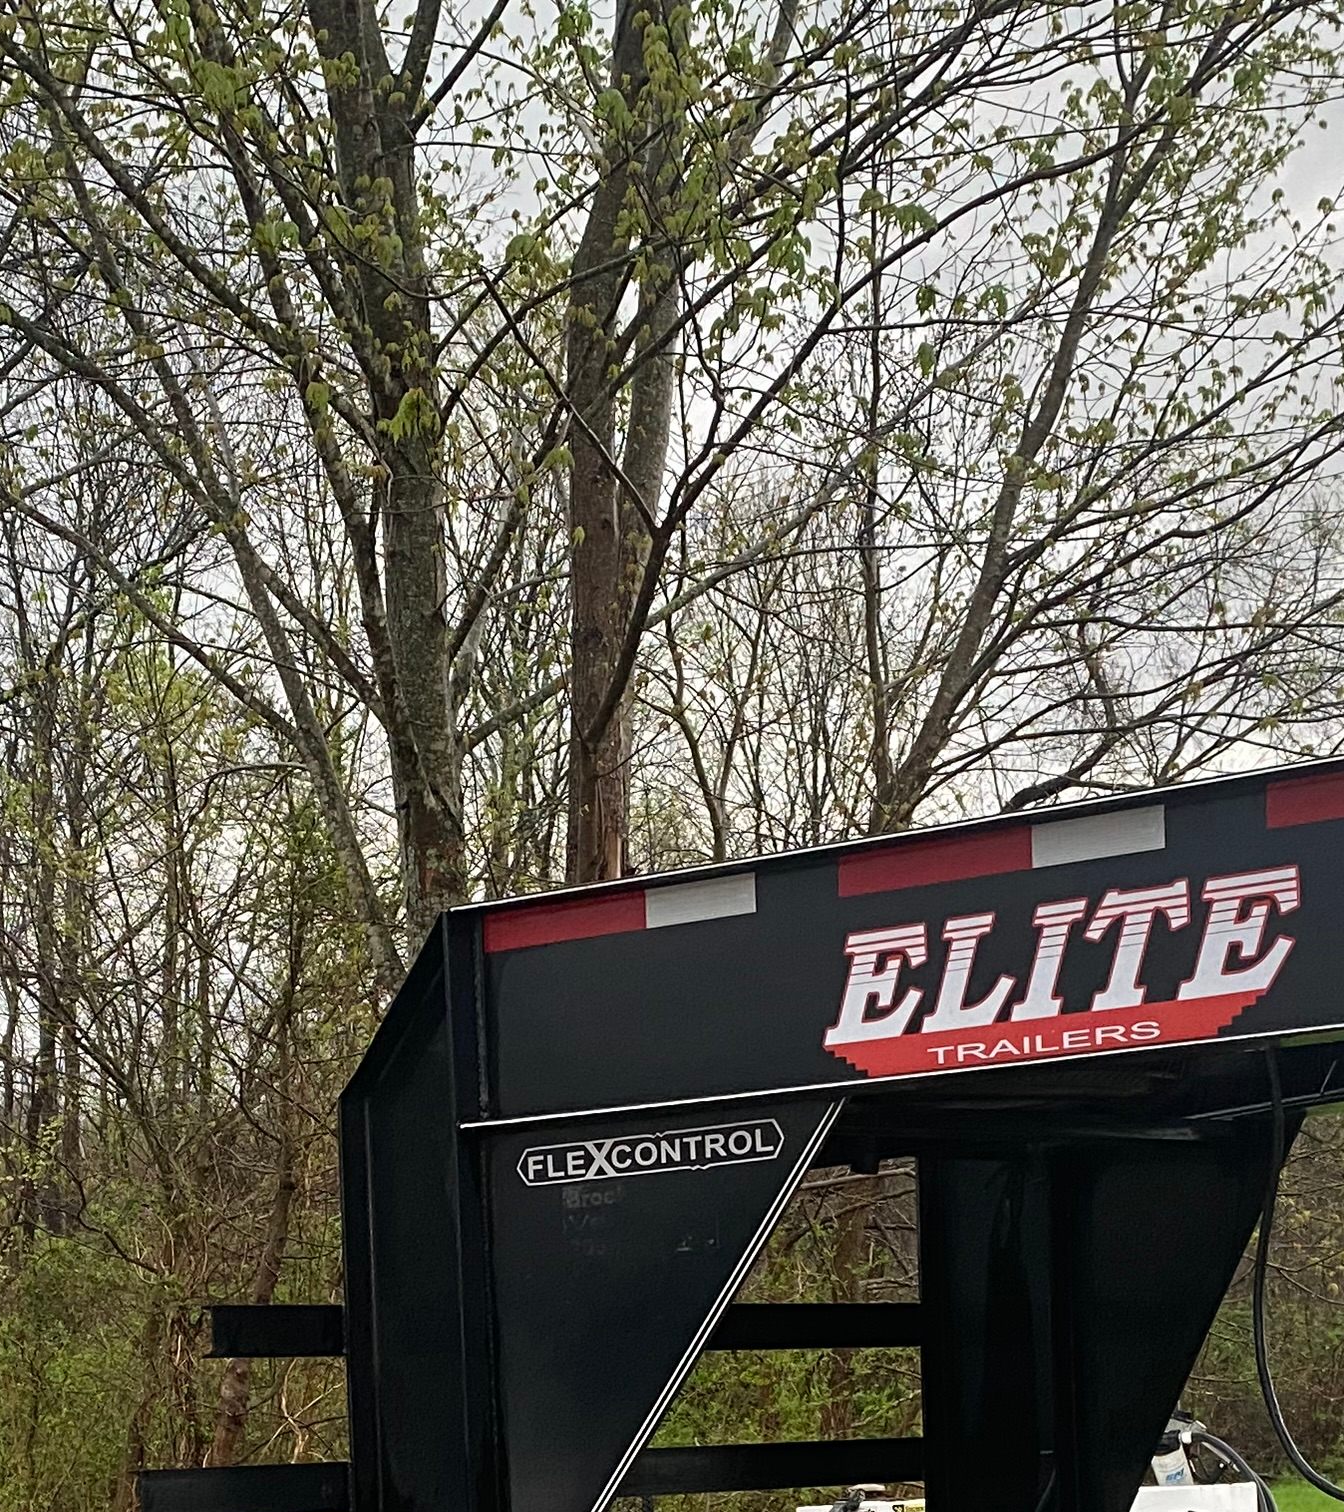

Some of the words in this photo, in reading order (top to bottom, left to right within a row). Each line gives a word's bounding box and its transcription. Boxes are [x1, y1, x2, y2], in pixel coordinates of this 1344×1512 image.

[823, 865, 1300, 1045] ELITE
[927, 1021, 1161, 1064] TRAILERS
[526, 1128, 775, 1180] FLEXCONTROL
